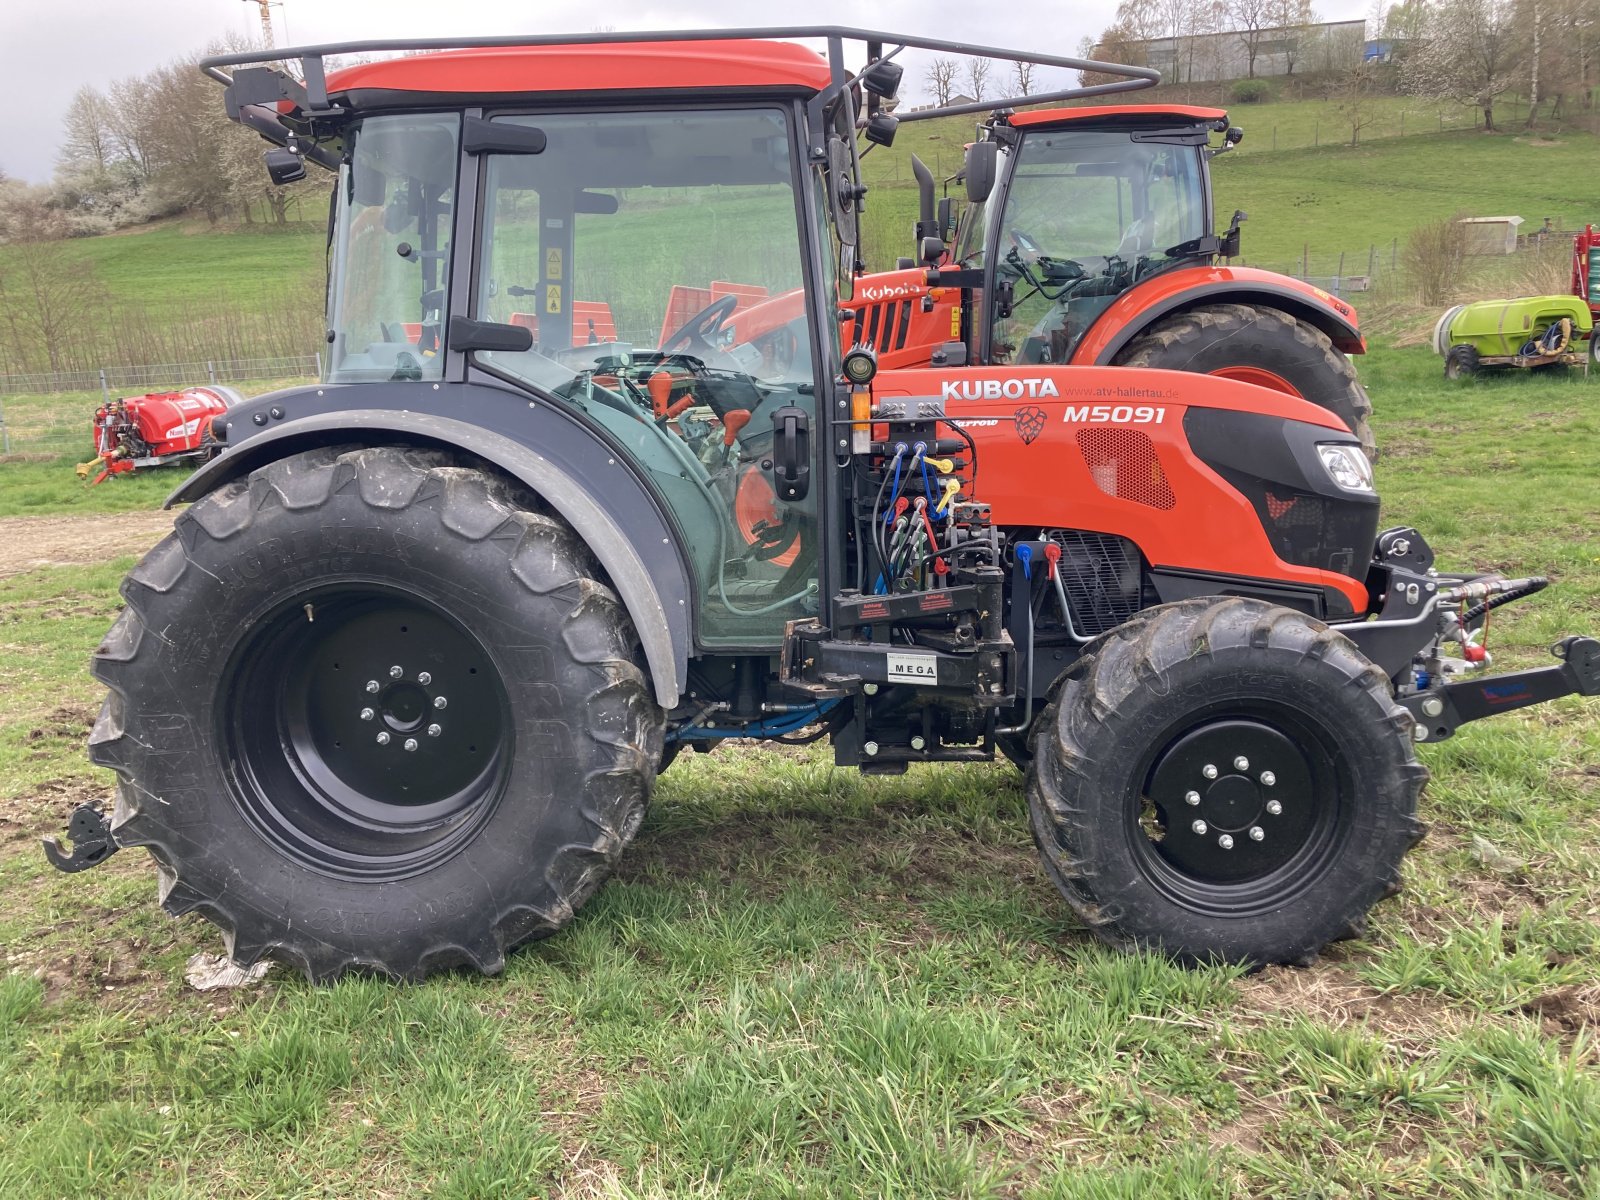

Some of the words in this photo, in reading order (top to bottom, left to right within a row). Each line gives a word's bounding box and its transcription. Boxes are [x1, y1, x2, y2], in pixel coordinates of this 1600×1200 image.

[941, 378, 1060, 401] KUBOTA
[1064, 387, 1179, 398] www.atv-hallertau.de
[1063, 406, 1166, 424] M5091
[895, 664, 934, 675] MEGA
